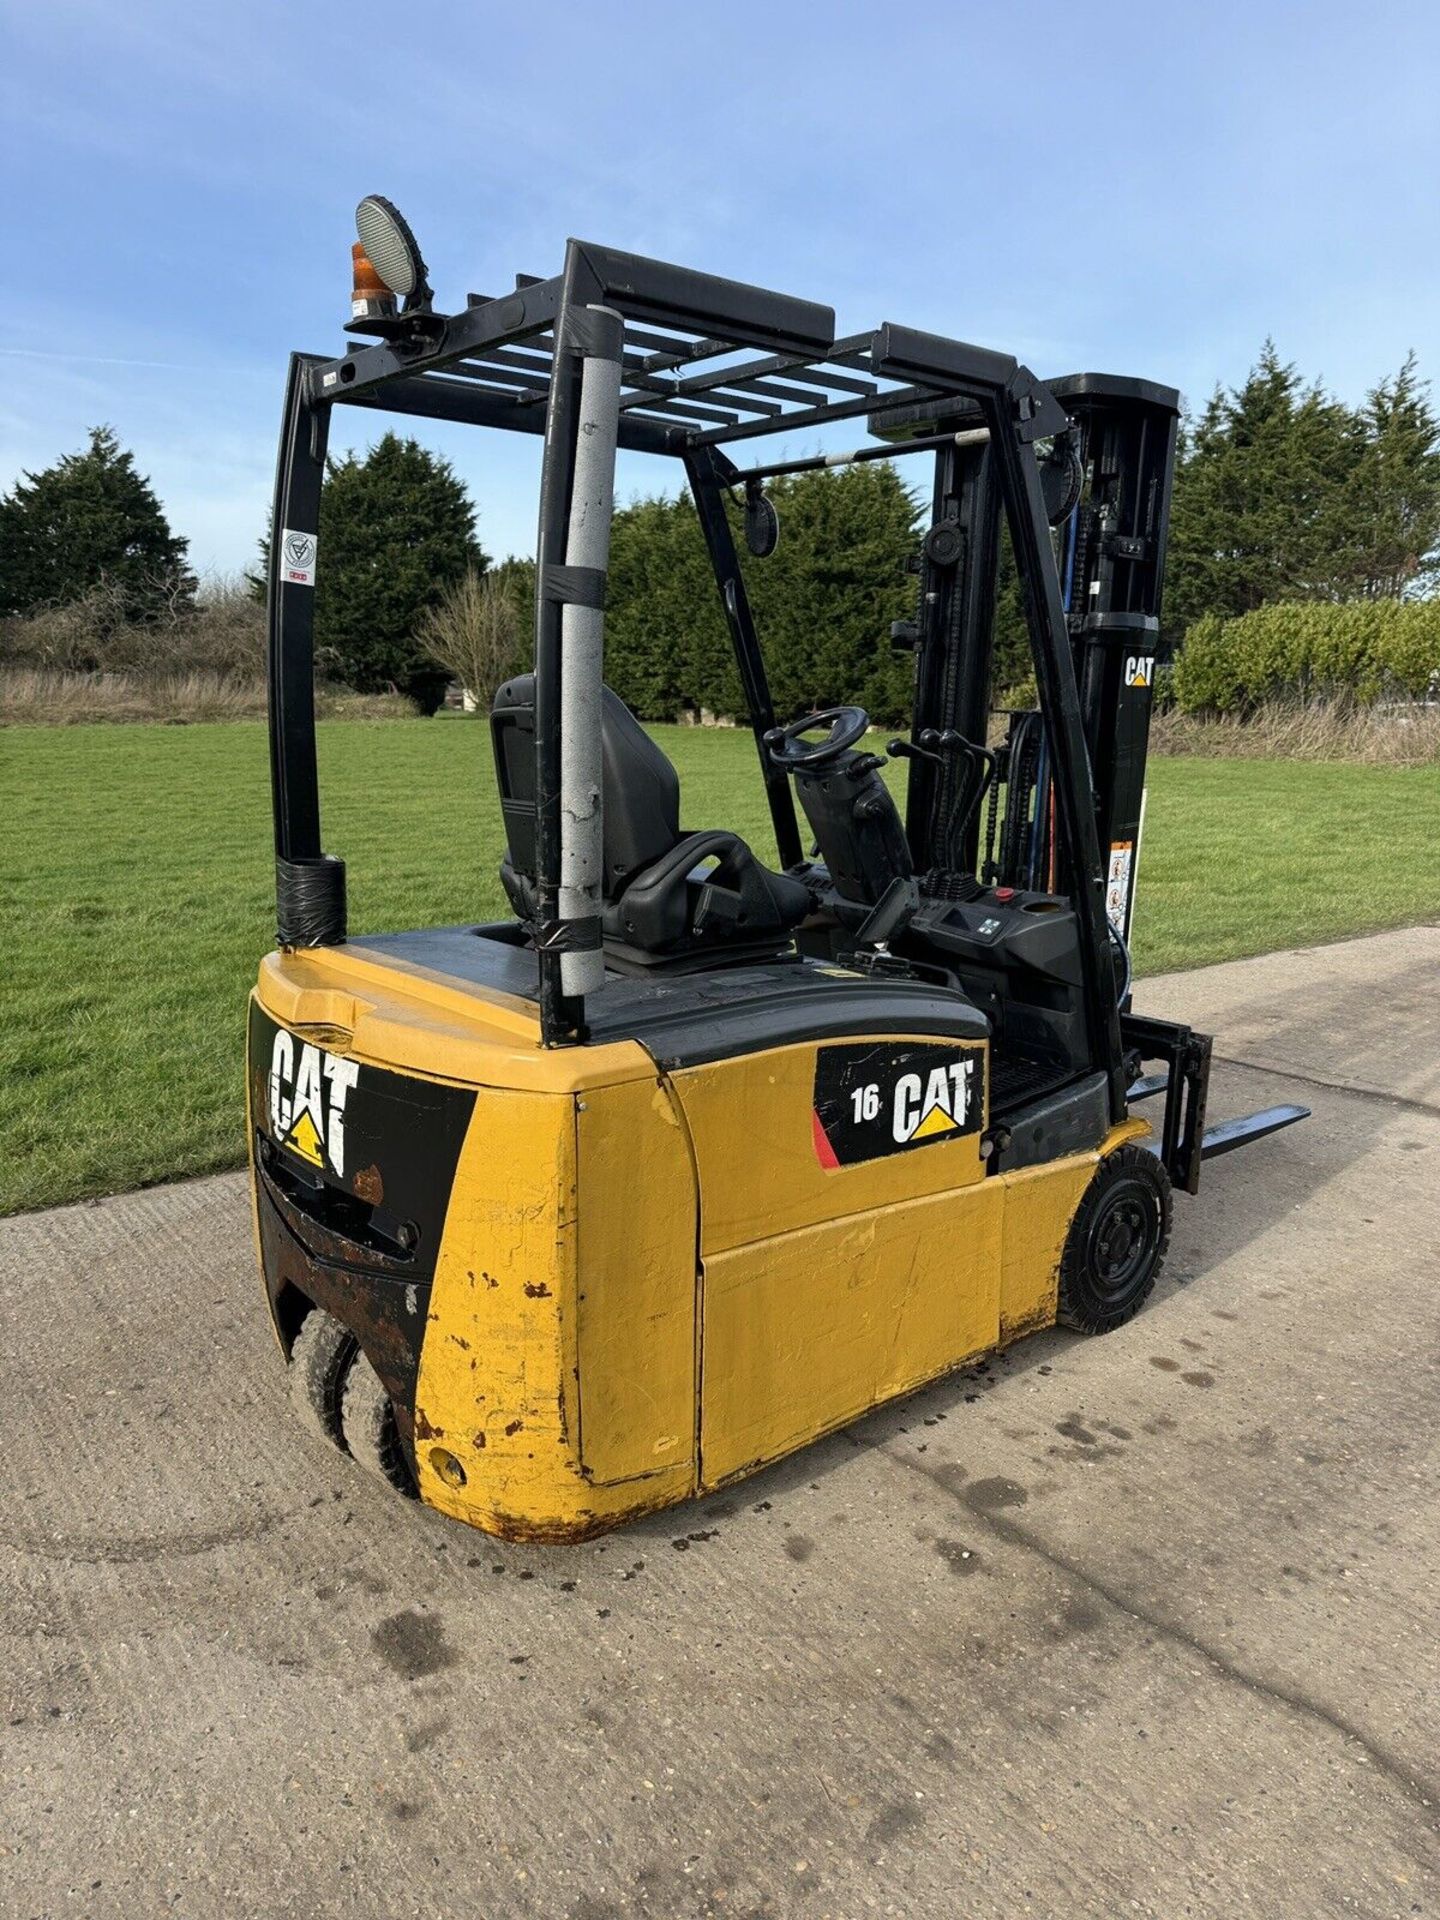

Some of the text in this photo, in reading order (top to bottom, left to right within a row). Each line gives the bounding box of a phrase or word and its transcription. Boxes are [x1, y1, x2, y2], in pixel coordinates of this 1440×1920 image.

[1125, 656, 1154, 686] CAT
[270, 1028, 360, 1178] CAT
[851, 1059, 974, 1143] 16 CAT
